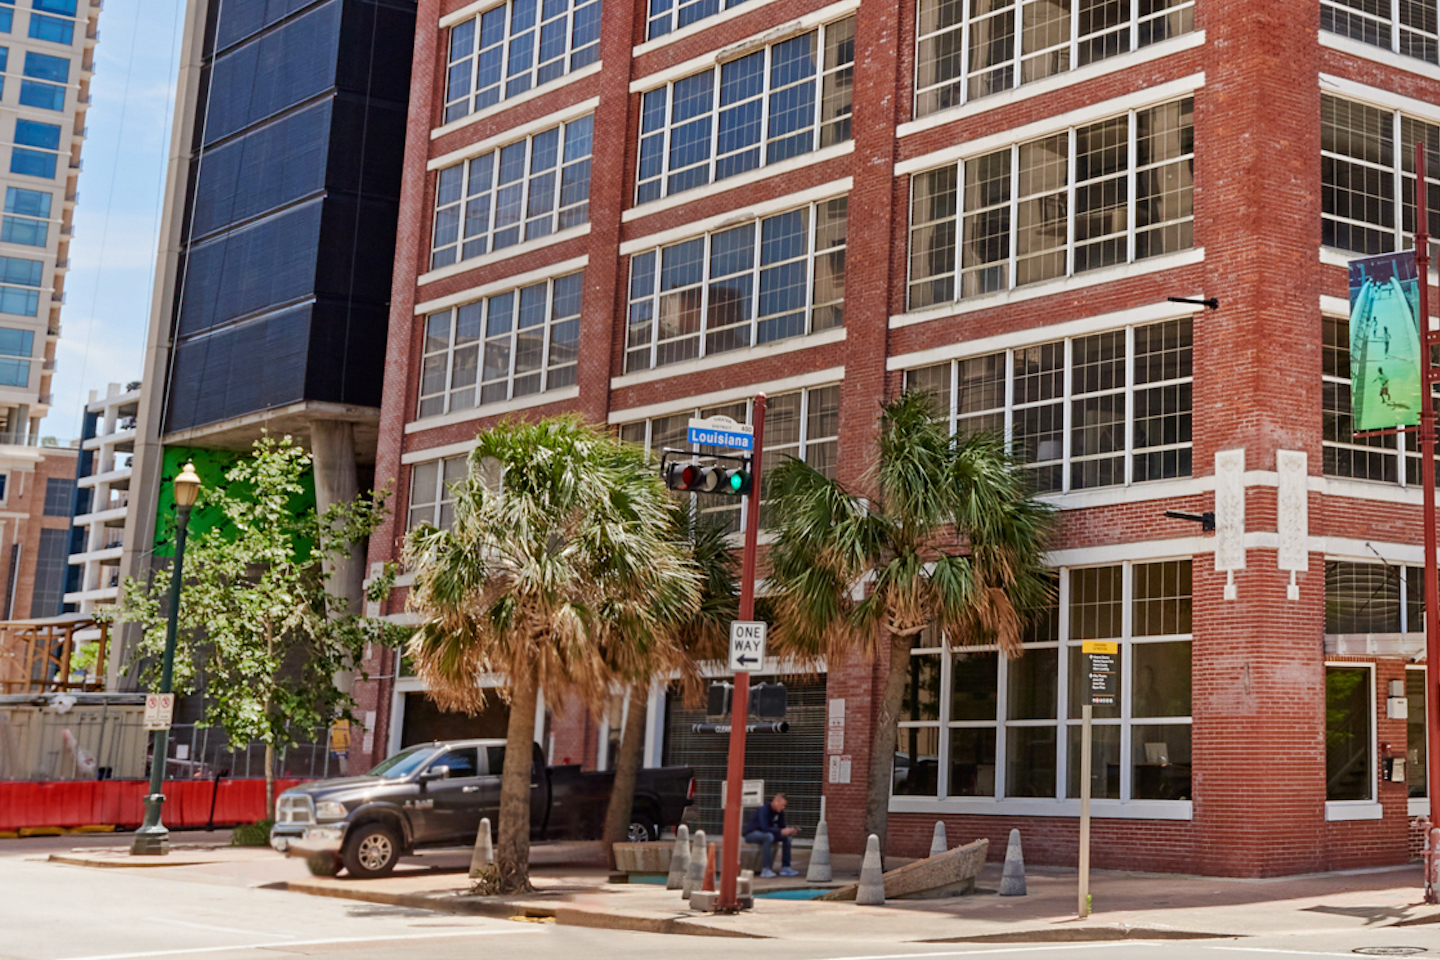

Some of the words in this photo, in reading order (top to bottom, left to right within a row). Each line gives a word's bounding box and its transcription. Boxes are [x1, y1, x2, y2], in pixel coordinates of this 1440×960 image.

[691, 429, 749, 448] Louisiana
[736, 626, 761, 638] ONE
[735, 640, 761, 652] WAY
